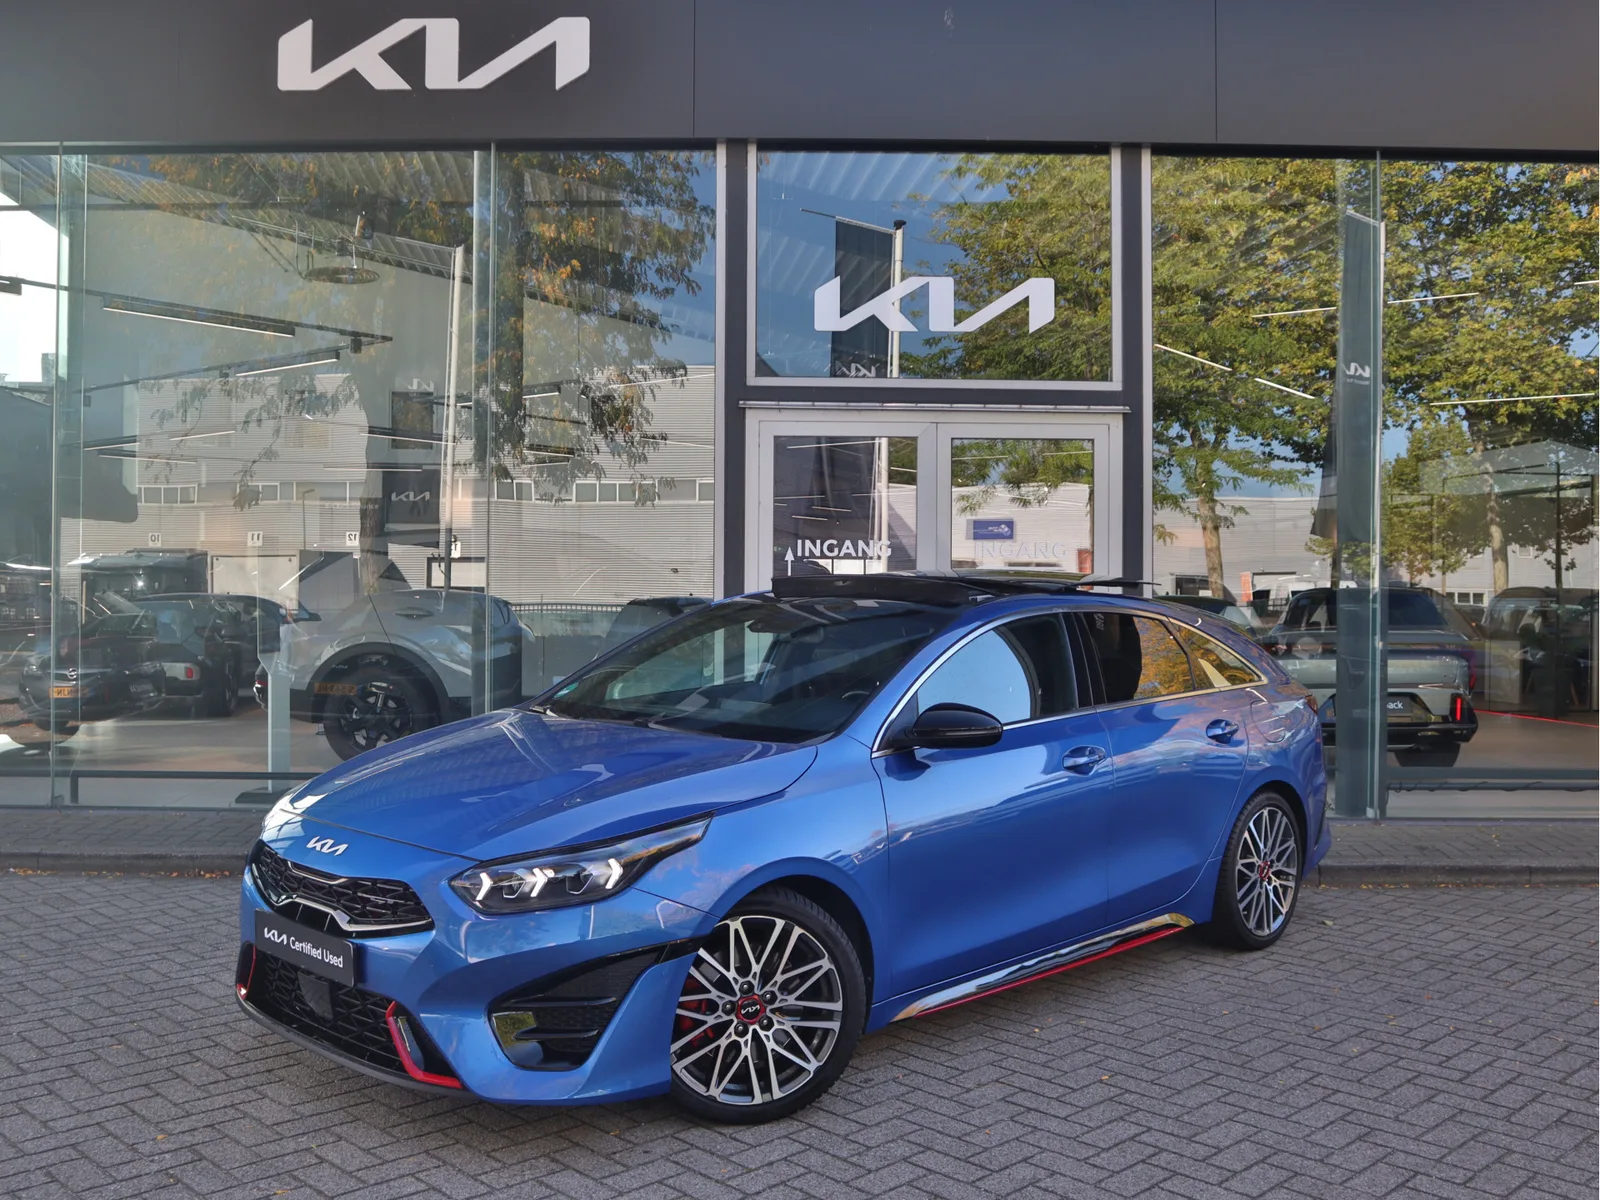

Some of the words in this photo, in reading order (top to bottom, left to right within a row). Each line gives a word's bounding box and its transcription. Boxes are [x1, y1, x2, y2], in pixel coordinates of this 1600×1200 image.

[277, 16, 590, 91] KIA
[814, 275, 1055, 334] KIA
[391, 491, 430, 502] KIA
[796, 539, 892, 557] INGANG
[974, 541, 1067, 560] INGANG
[306, 836, 349, 856] KIA
[264, 927, 288, 946] KIA
[289, 936, 322, 960] Certified
[323, 950, 344, 968] Used
